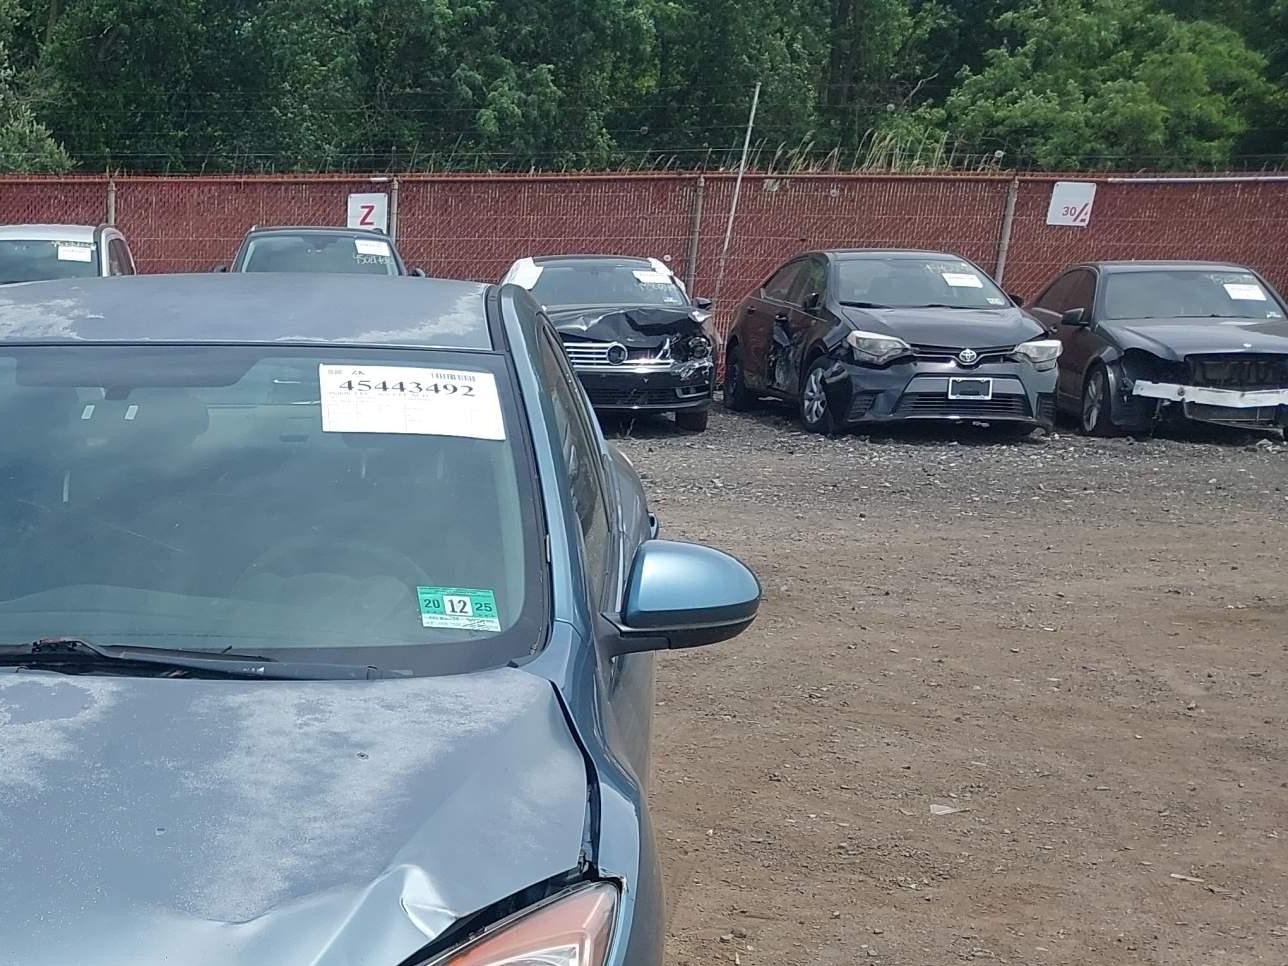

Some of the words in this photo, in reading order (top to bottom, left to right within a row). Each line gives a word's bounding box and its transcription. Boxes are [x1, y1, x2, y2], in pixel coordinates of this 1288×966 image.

[359, 205, 376, 226] Z
[1062, 206, 1077, 217] 30
[338, 379, 476, 398] 45443492
[423, 598, 441, 609] 20
[447, 598, 469, 615] 12
[474, 602, 493, 613] 25
